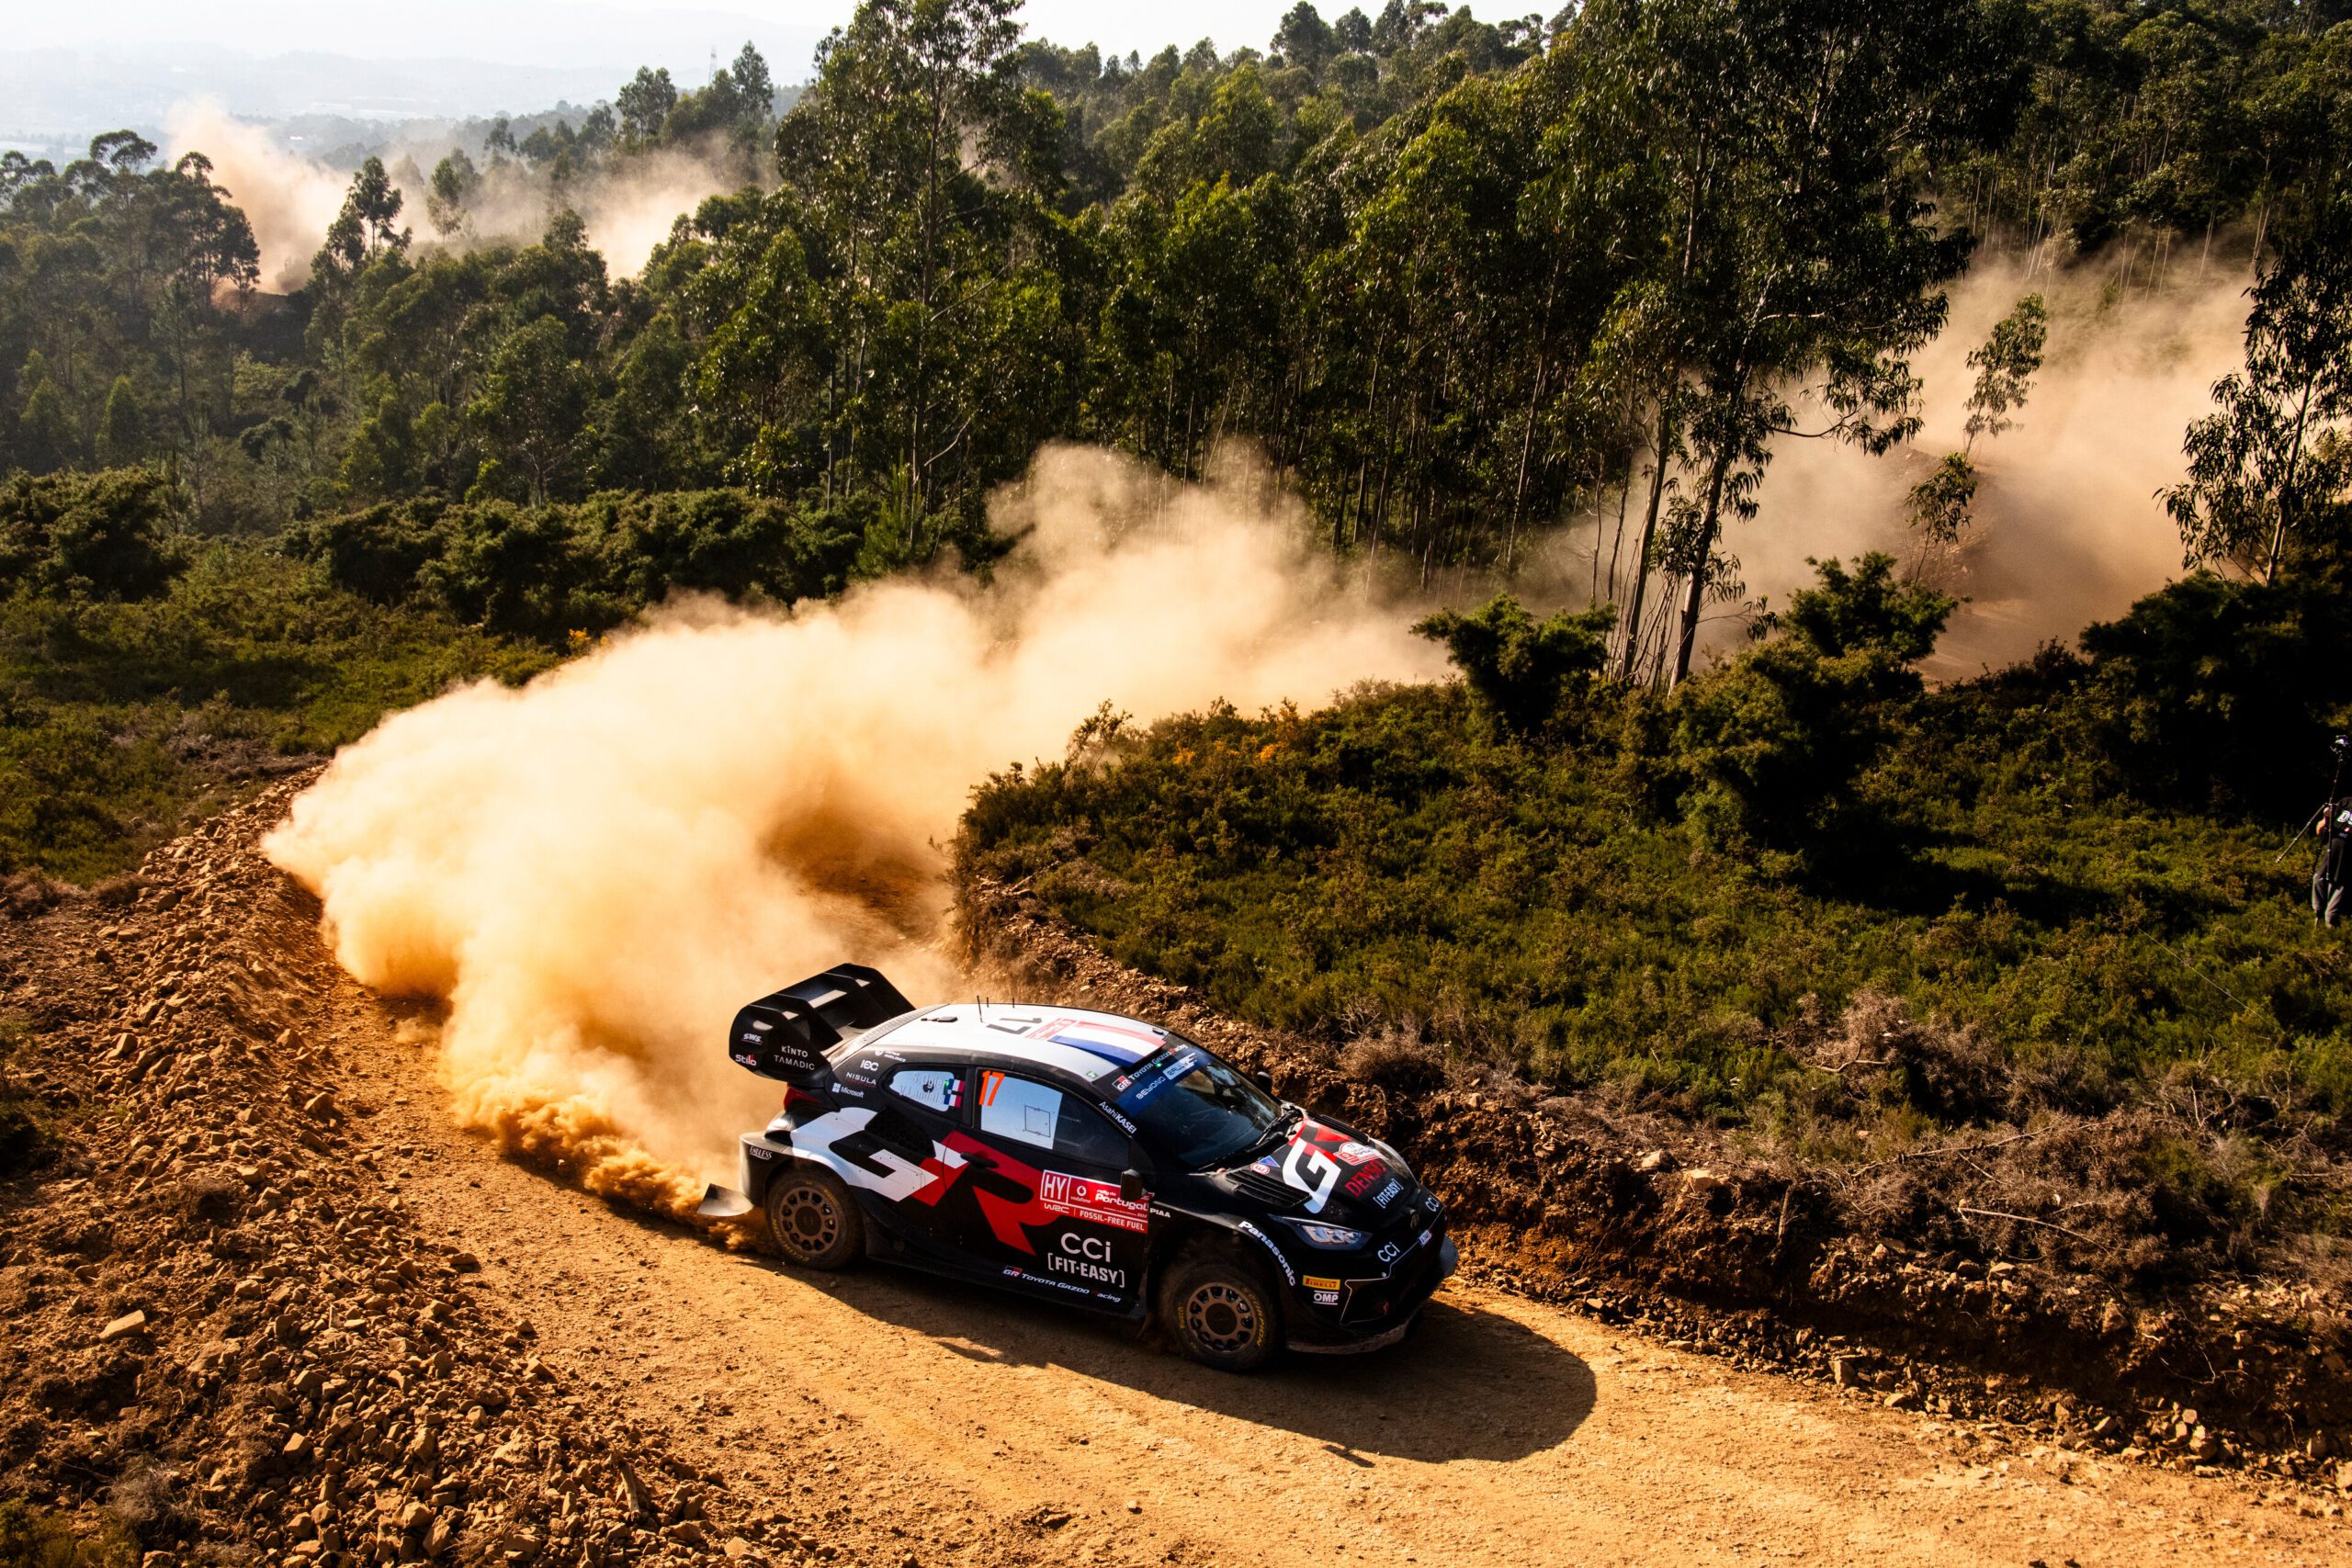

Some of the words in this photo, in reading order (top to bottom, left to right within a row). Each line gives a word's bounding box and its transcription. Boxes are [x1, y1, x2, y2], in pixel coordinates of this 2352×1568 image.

[735, 1054, 757, 1066] Stilo
[774, 1055, 815, 1071] TAMADIC
[846, 1072, 876, 1086] NISULA
[1128, 1062, 1154, 1080] TOYOTA
[840, 1086, 865, 1099] Microsoft
[978, 1070, 1005, 1107] 17
[1136, 1076, 1167, 1100] BEYOND
[1345, 1159, 1387, 1198] DENSO
[1044, 1174, 1068, 1200] HY
[1044, 1202, 1069, 1213] WRC
[1095, 1193, 1148, 1212] Portugal
[1080, 1210, 1125, 1226] FOSSIL-FREE
[1126, 1221, 1145, 1231] FUEL
[1149, 1207, 1171, 1218] PIAA
[1238, 1220, 1296, 1287] Panasonic
[1022, 1272, 1057, 1286] TOYOTA
[1305, 1278, 1339, 1289] PIRELLI
[1313, 1292, 1340, 1303] OMP
